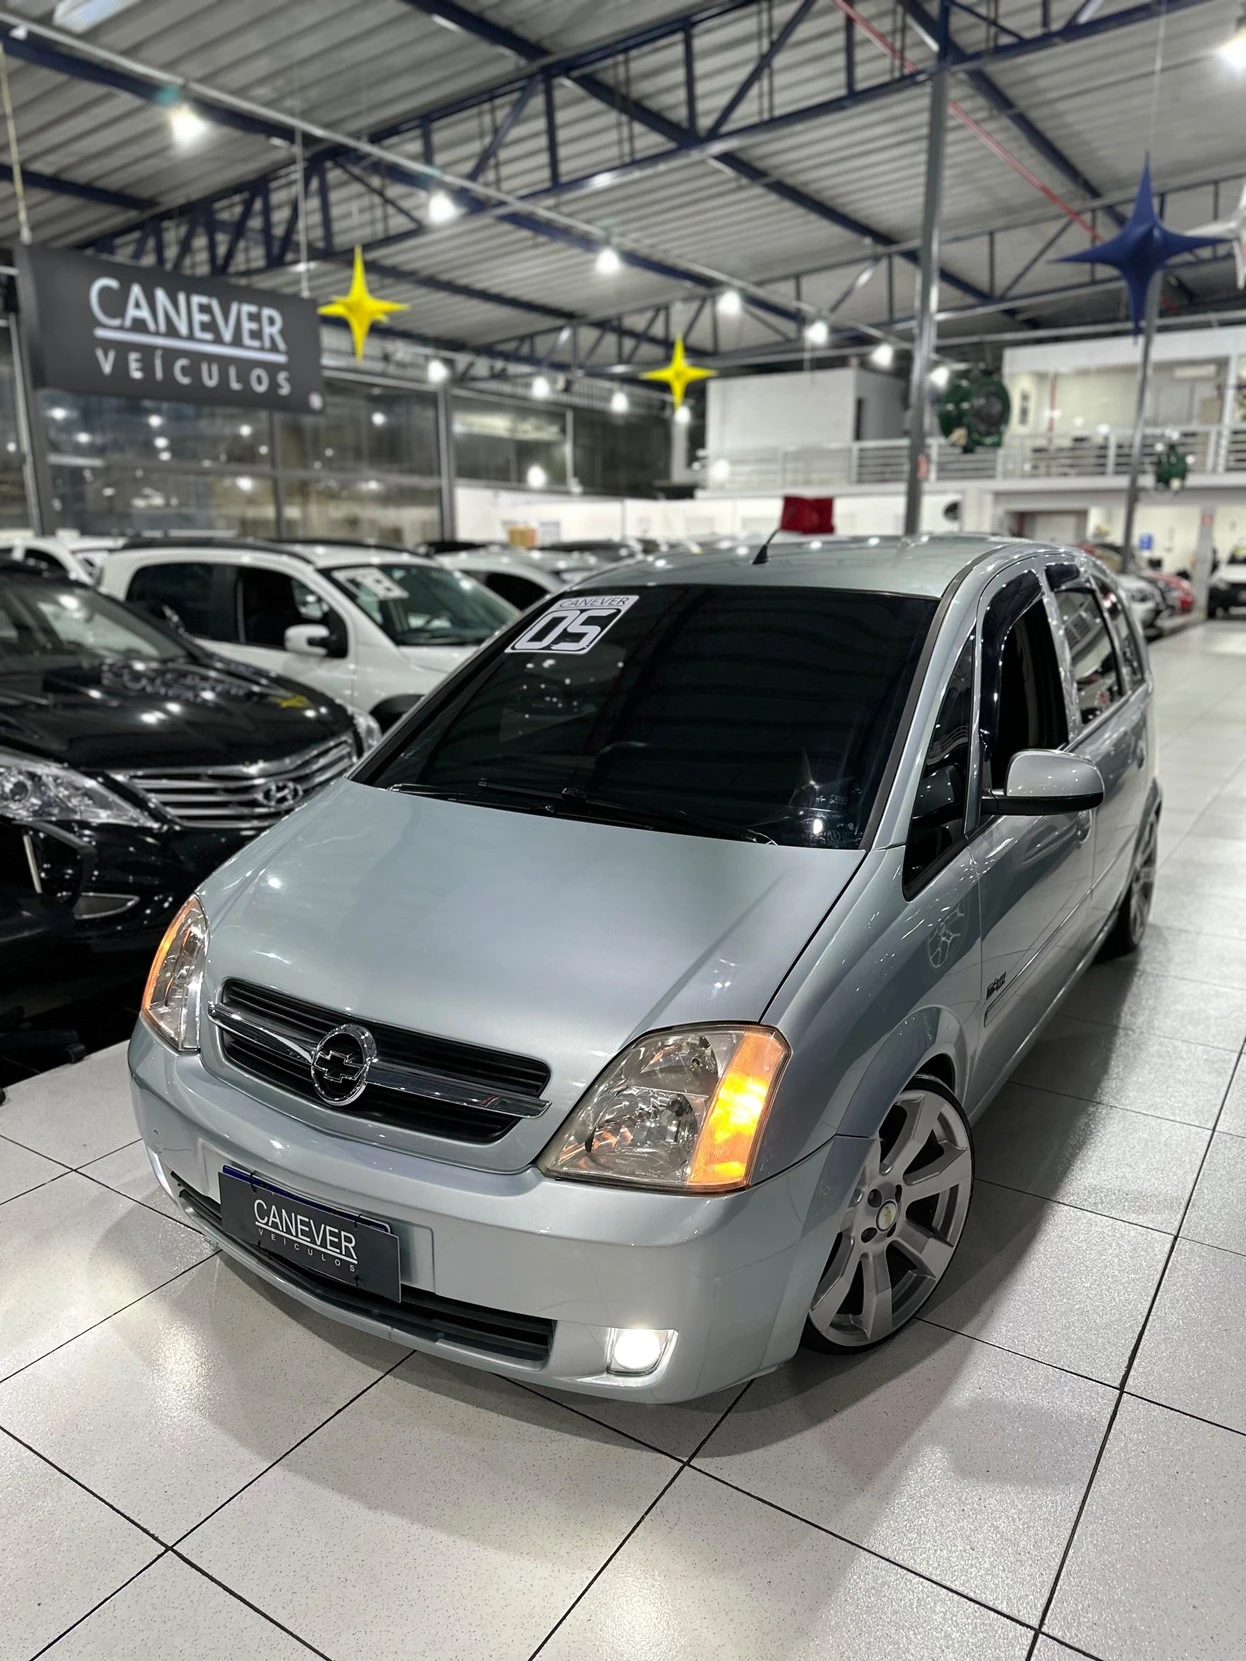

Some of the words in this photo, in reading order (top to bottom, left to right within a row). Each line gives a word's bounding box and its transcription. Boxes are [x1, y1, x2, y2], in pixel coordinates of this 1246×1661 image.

[90, 277, 286, 350] CANEVER
[95, 347, 291, 396] VEÍCULOS
[559, 597, 630, 608] CANEVER
[514, 609, 618, 651] 05
[254, 1199, 358, 1260] CANEVER
